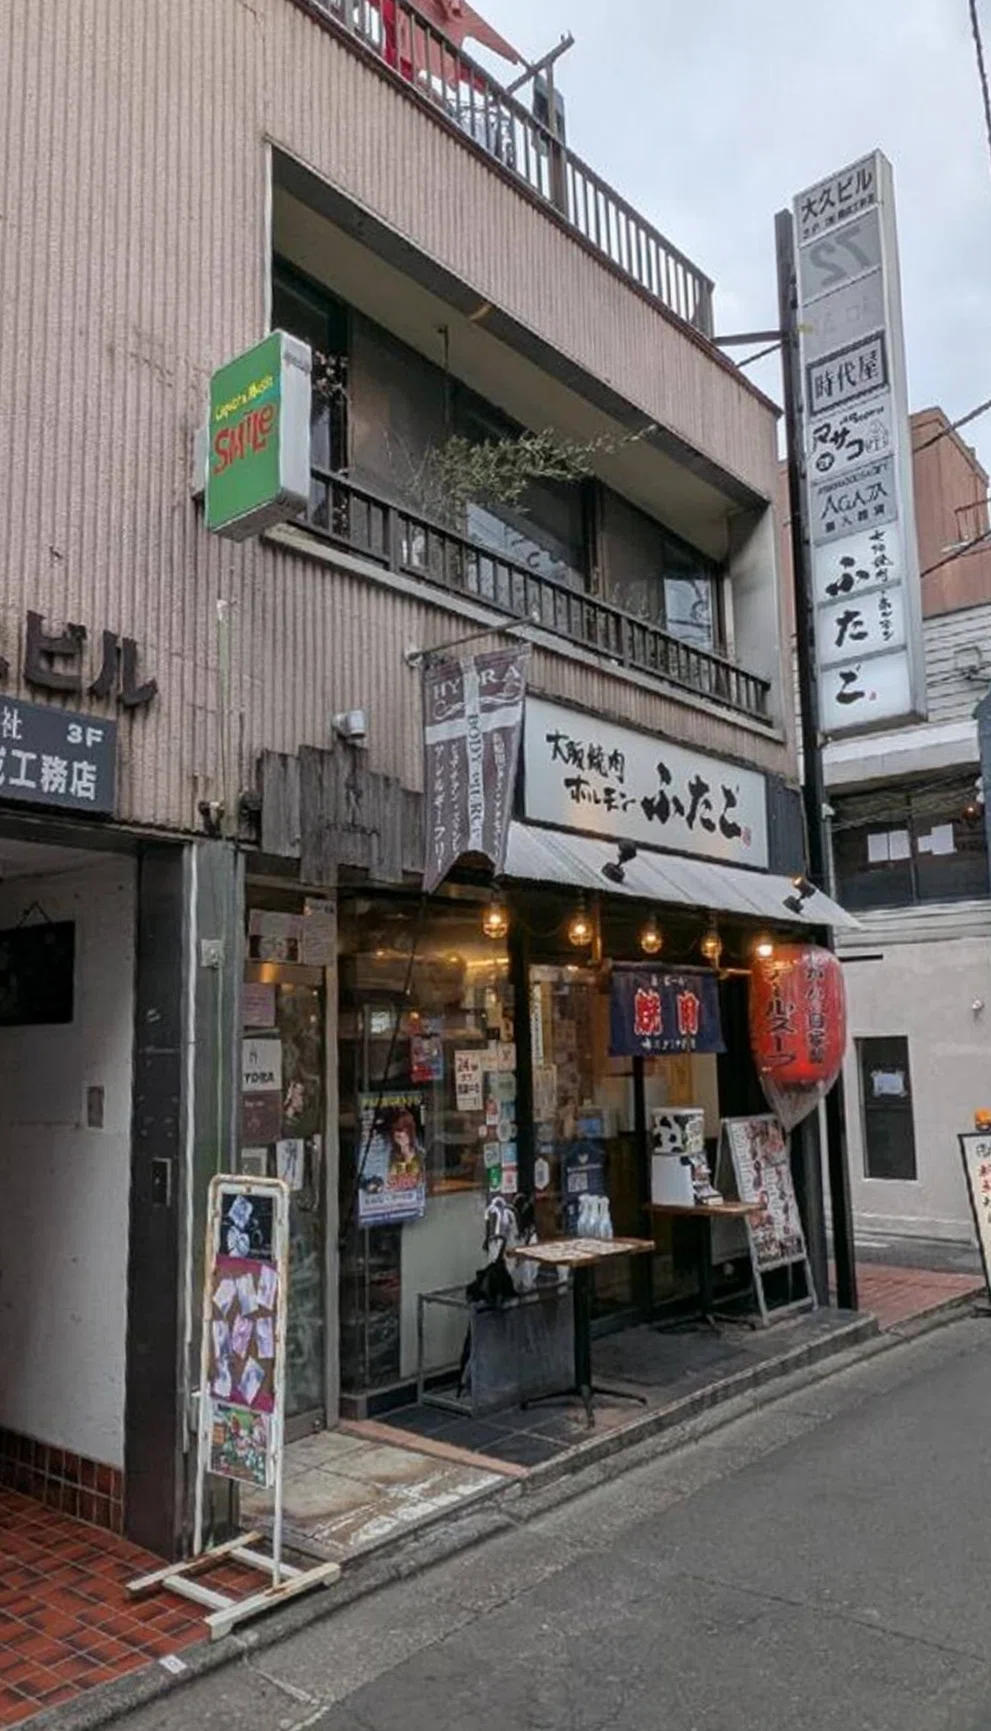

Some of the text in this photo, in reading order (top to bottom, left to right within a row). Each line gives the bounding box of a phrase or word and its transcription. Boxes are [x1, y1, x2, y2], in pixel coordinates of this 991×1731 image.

[801, 168, 873, 223] 大久ビル
[815, 350, 878, 399] 時代屋
[812, 422, 865, 462] マサコ
[824, 555, 870, 705] ふたご
[0, 610, 158, 707] ビル
[1, 705, 104, 747] 社 3F
[546, 730, 625, 784] 大阪焼肉
[564, 774, 636, 812] ホルモン
[641, 762, 742, 840] ふたご
